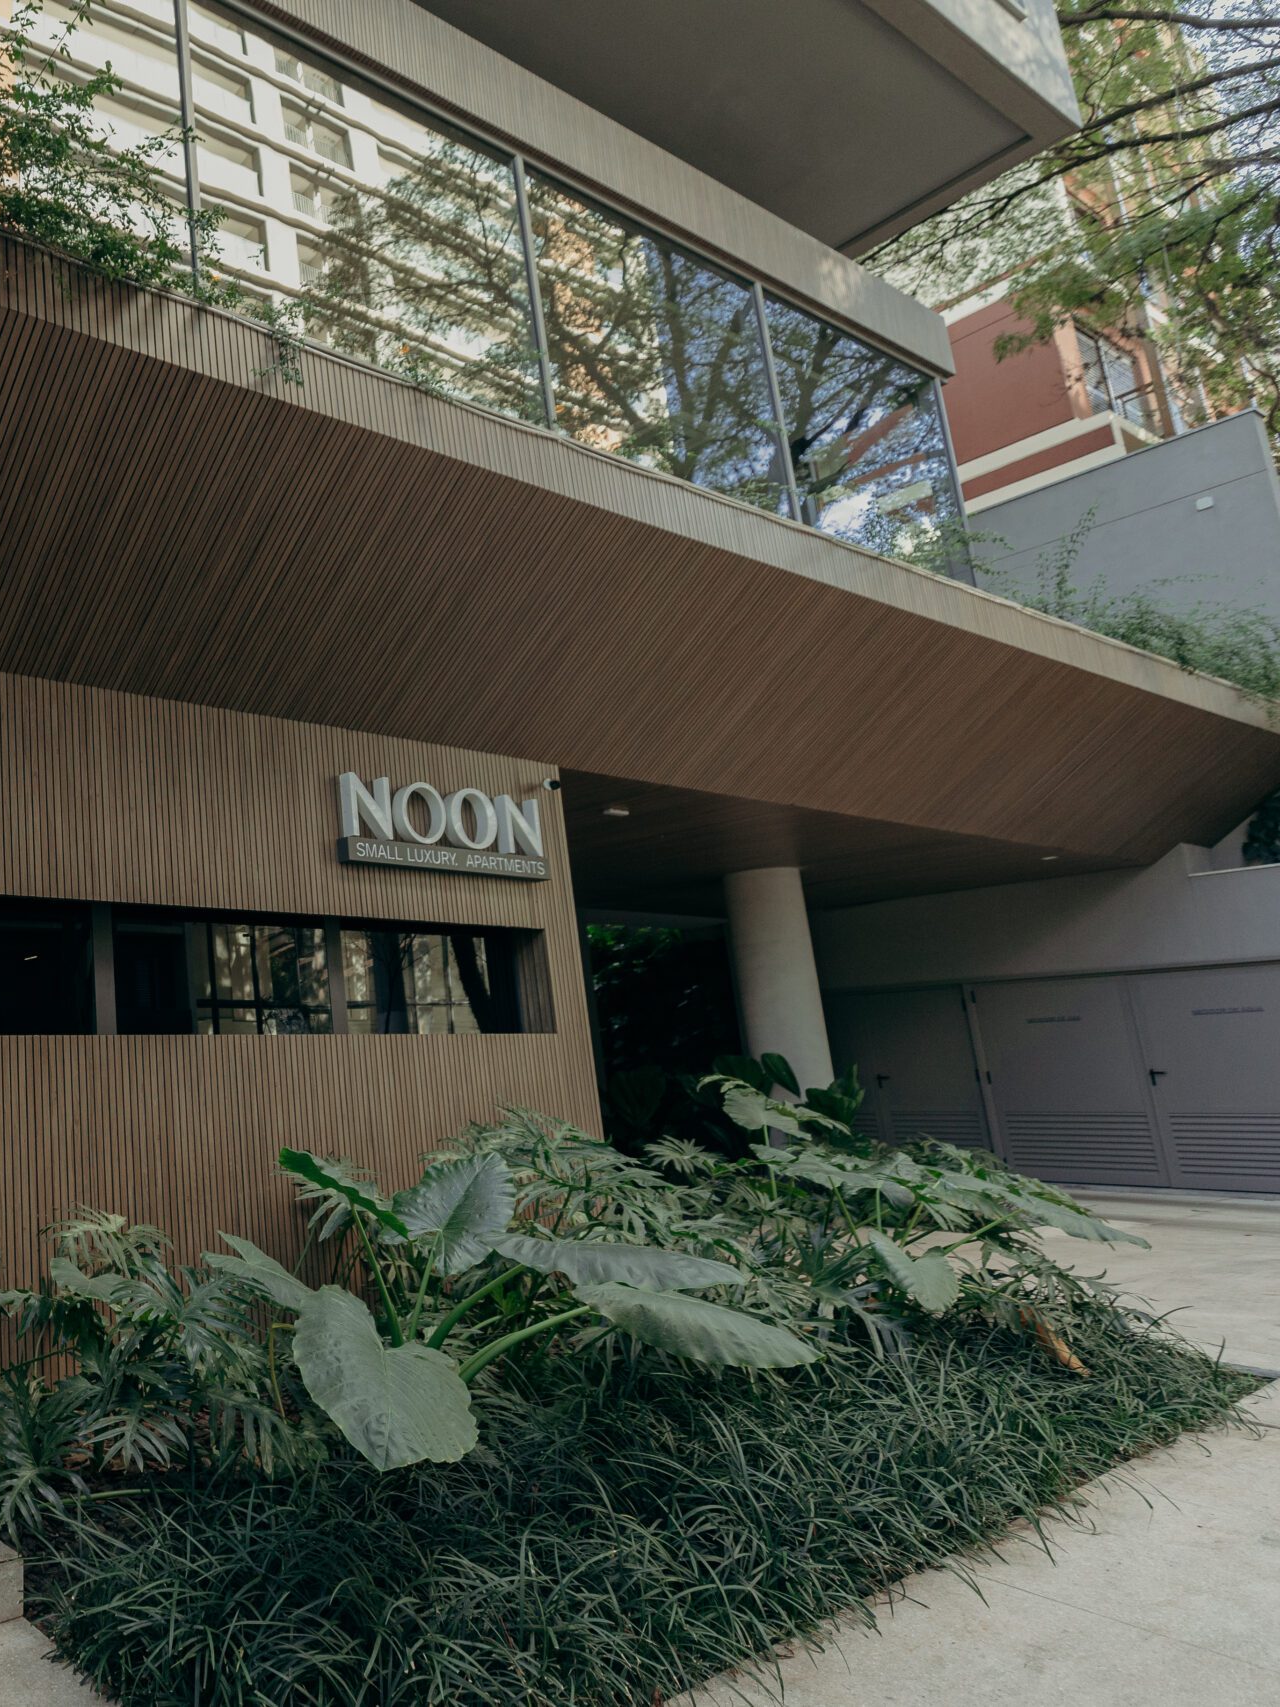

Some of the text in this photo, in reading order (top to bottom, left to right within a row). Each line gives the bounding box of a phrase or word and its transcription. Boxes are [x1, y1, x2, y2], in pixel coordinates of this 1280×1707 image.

[339, 772, 543, 857] NOON
[356, 842, 404, 861] SMALL
[466, 854, 545, 875] APARTMENTS
